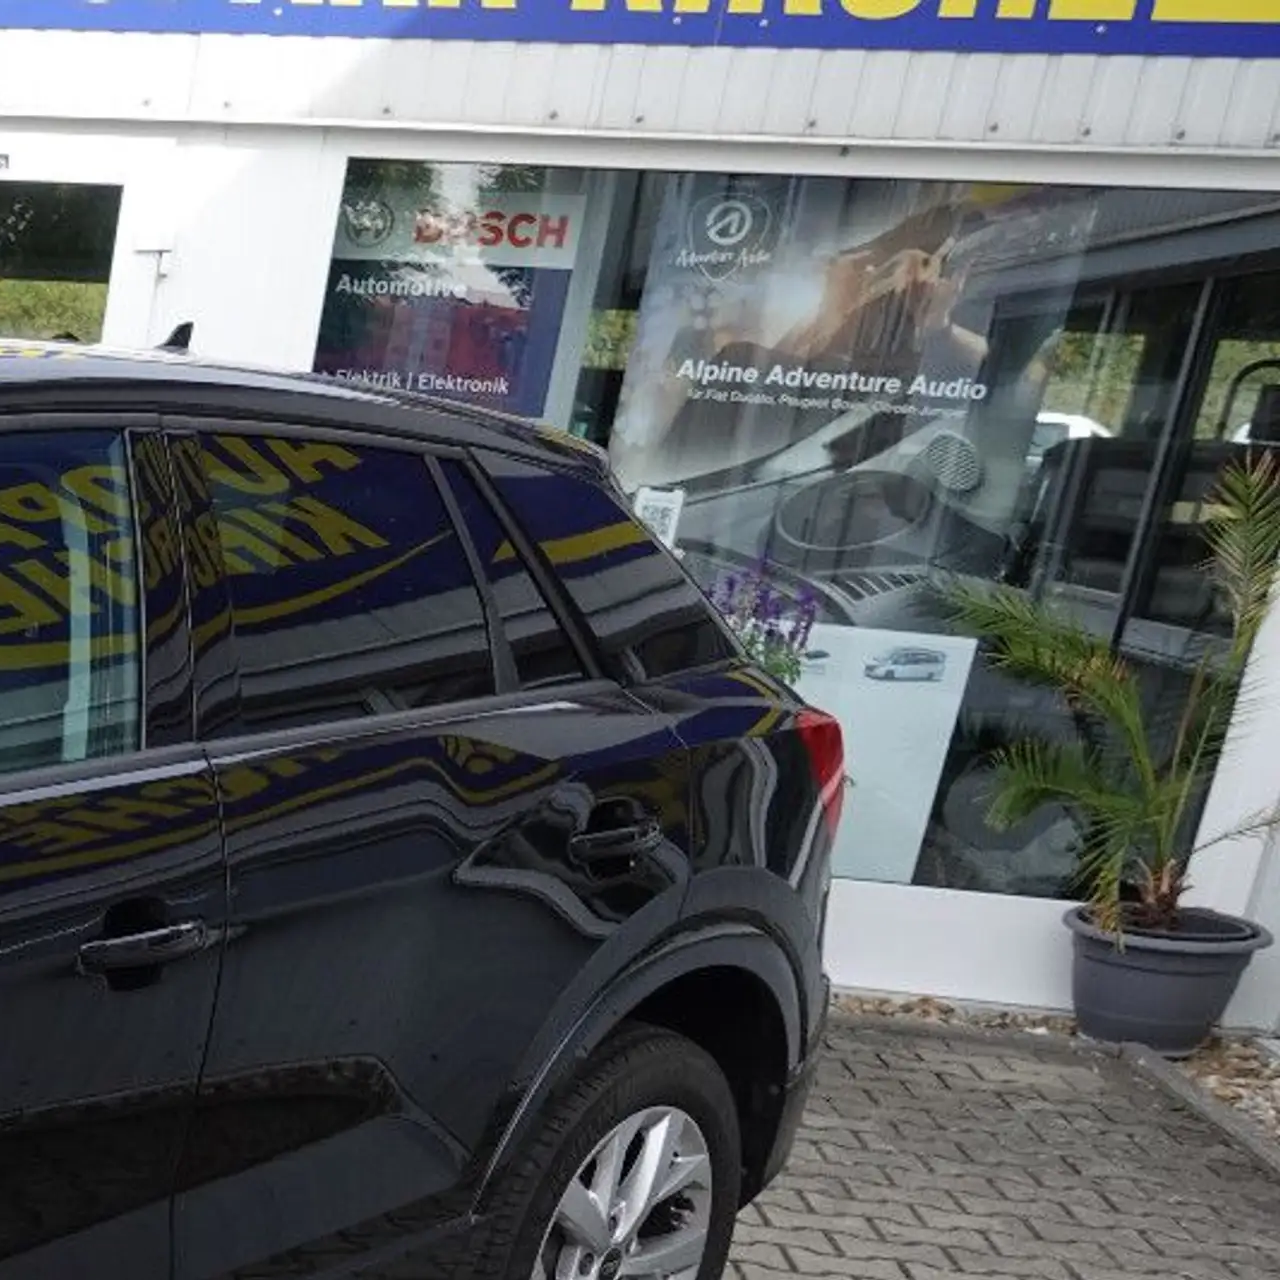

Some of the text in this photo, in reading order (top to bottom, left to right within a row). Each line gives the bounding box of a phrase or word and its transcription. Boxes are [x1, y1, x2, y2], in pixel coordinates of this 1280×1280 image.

[336, 274, 468, 298] Automotive
[418, 373, 509, 394] Elektronik
[676, 359, 987, 400] Alpine Adventure Audio
